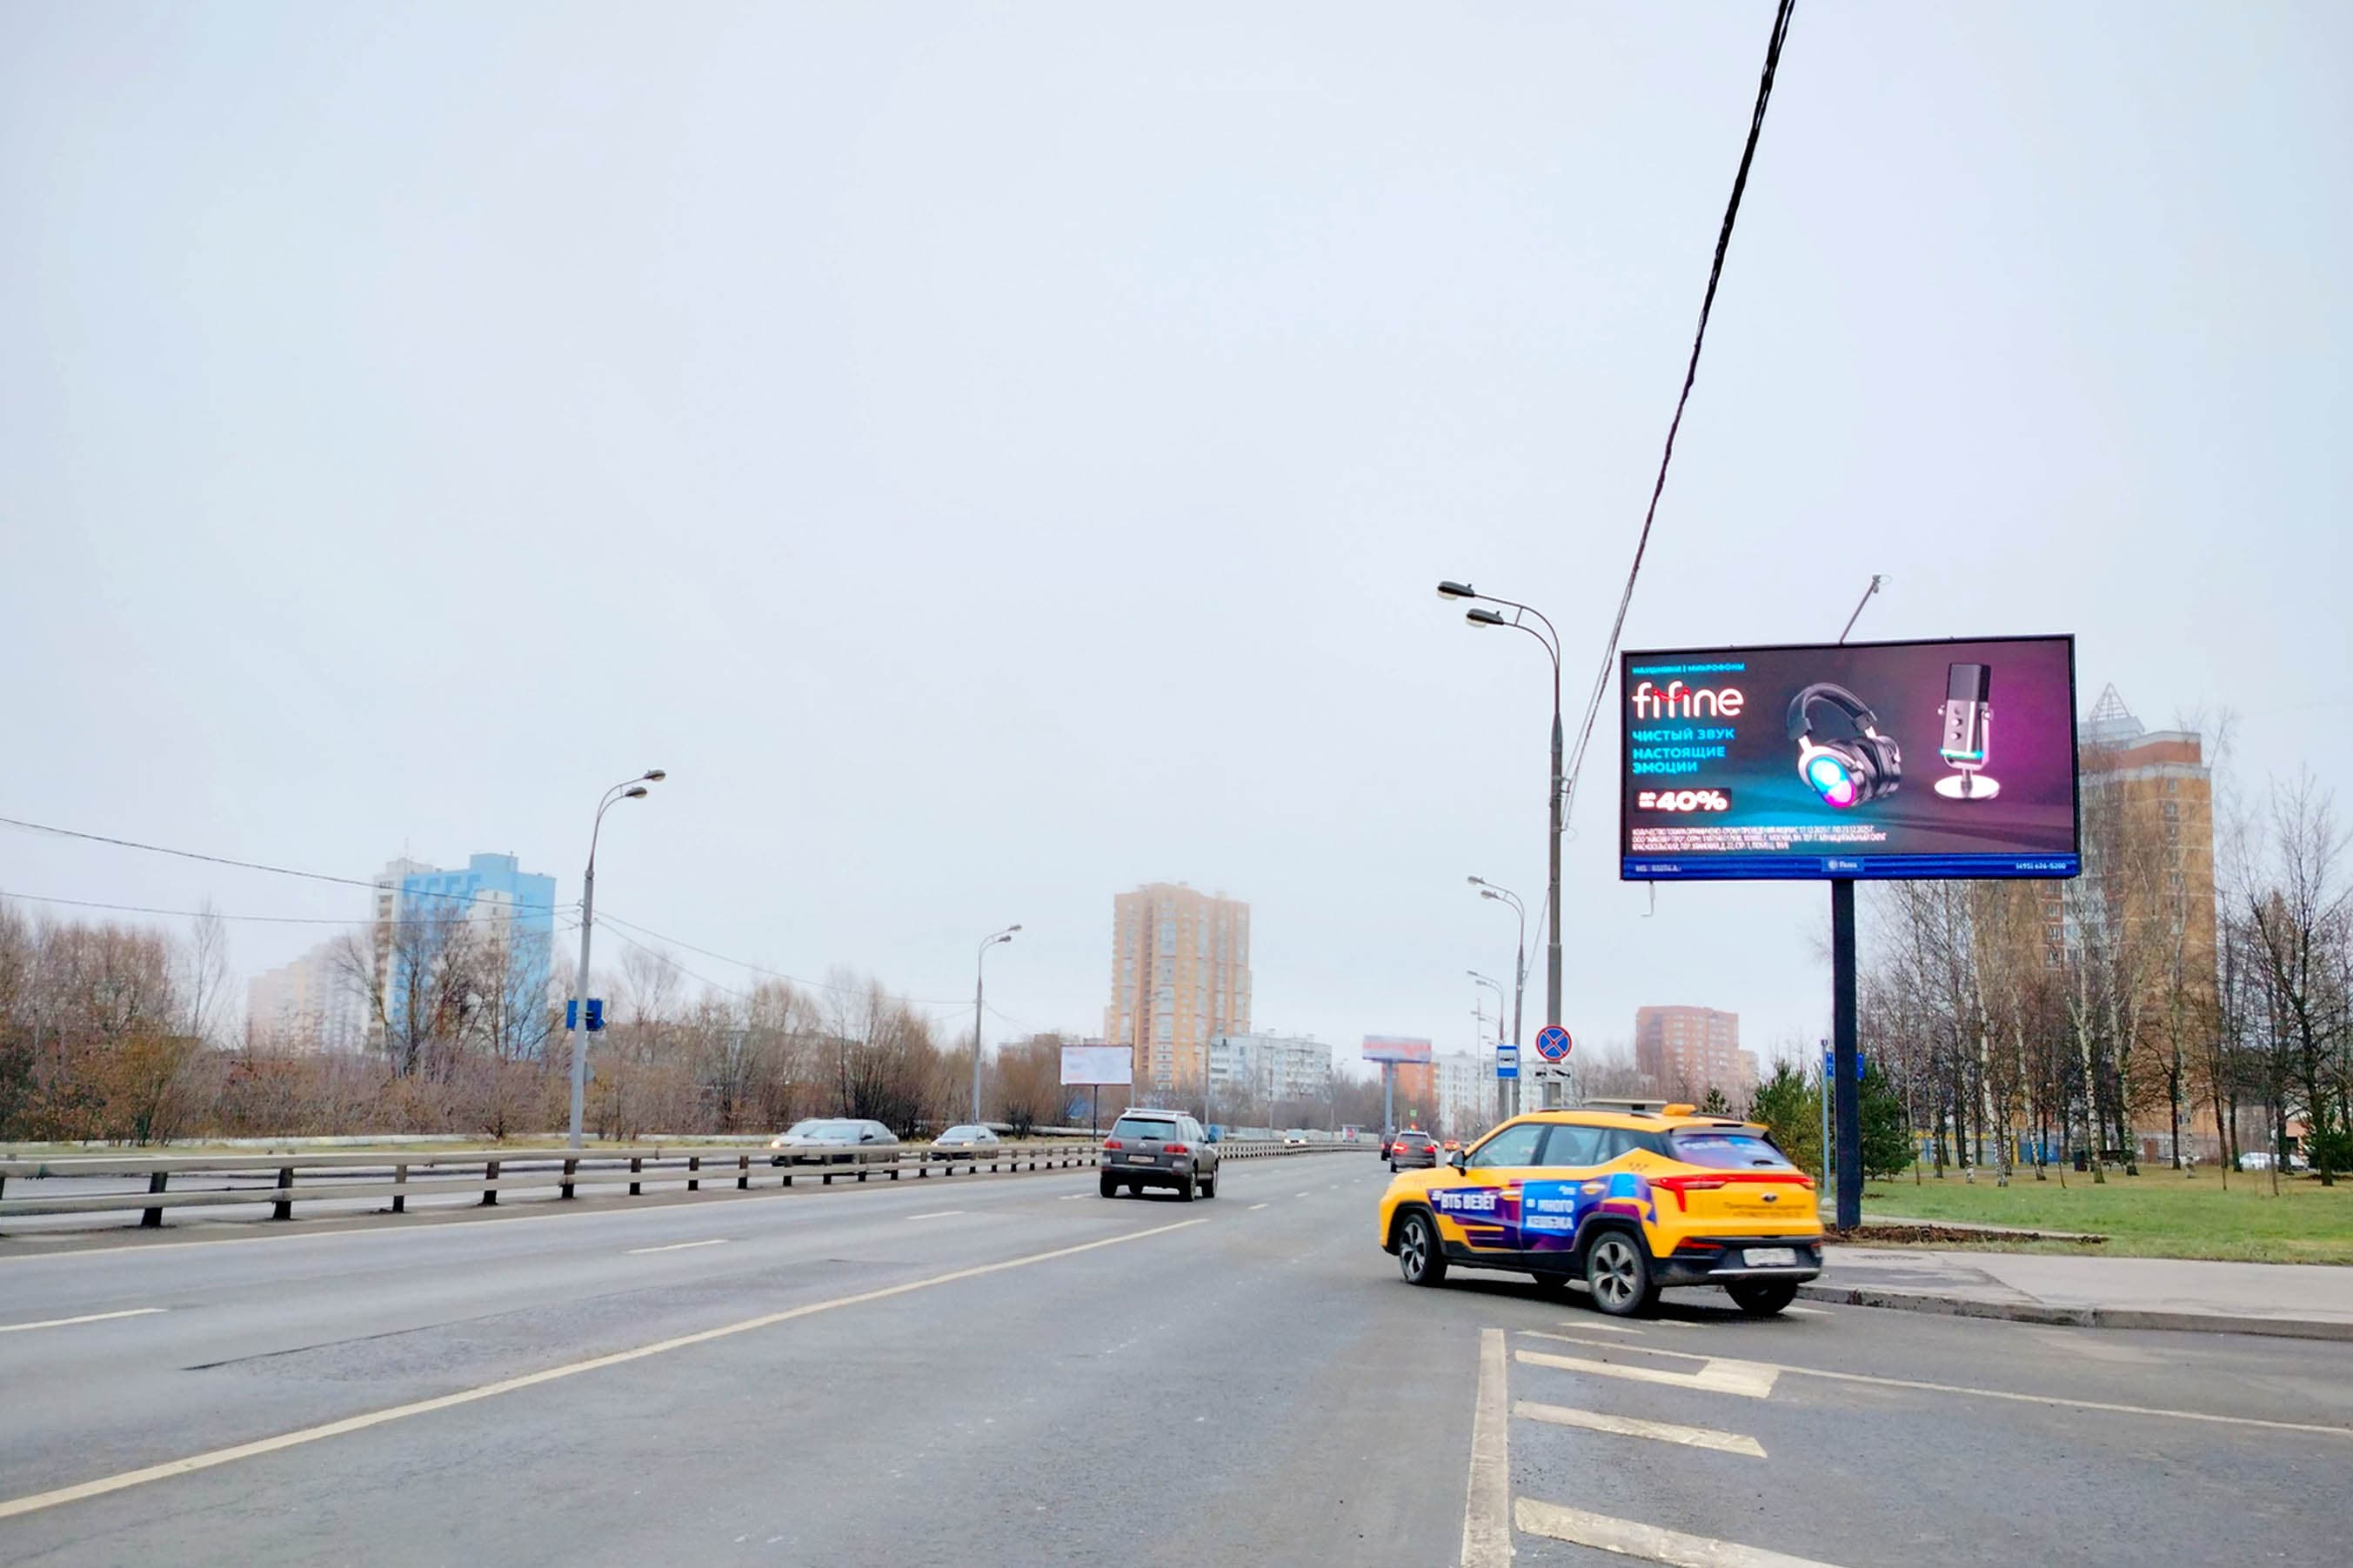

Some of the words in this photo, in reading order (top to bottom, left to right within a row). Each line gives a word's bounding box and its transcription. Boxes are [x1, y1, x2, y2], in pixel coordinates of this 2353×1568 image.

[1632, 681, 1744, 718] fifine
[1632, 727, 1694, 742] ЧИСТЫЙ
[1697, 728, 1735, 740] ЗВУК
[1633, 746, 1726, 759] НАСТОЯЩИЕ
[1632, 761, 1698, 775] ЭМОЦИИ
[1441, 1194, 1461, 1209] ВТБ
